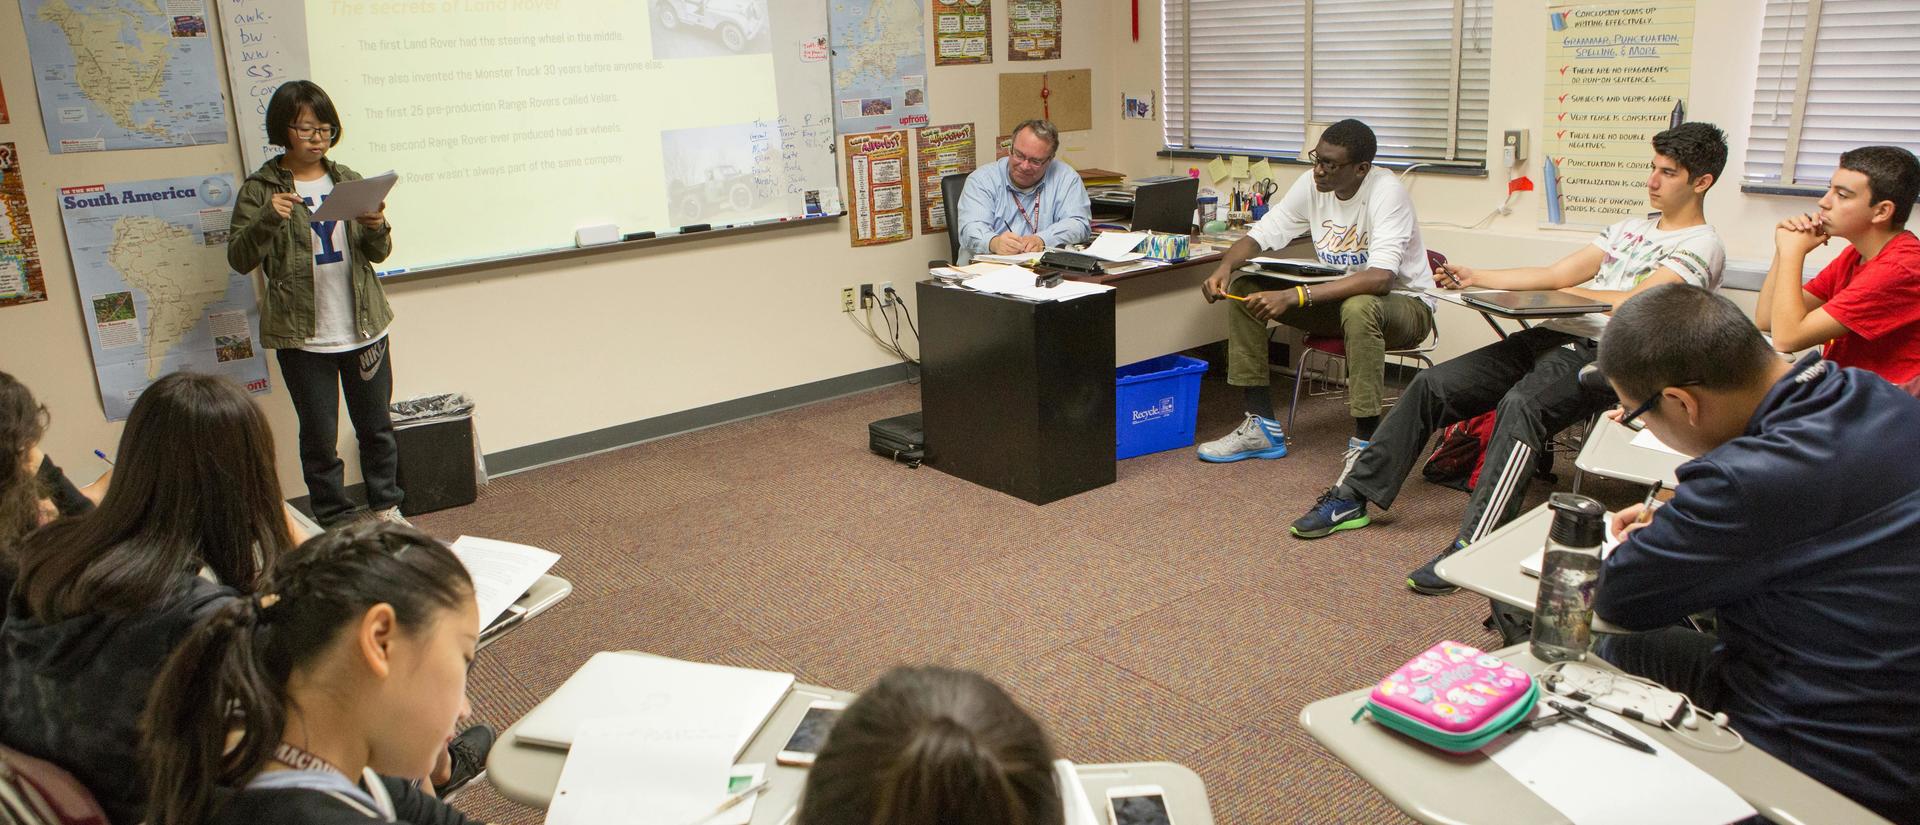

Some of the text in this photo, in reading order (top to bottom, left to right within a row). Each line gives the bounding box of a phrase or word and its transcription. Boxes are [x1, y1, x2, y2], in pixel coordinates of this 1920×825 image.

[329, 0, 560, 15] The secrets of Land Rover
[1575, 7, 1657, 18] CONCLUSION SUMS UP
[1575, 18, 1654, 28] WRITING EFFECTIVELY.
[358, 39, 377, 50] The
[380, 38, 401, 50] first
[403, 37, 427, 50] Land
[430, 36, 456, 49] Rover
[460, 35, 477, 48] had
[480, 35, 495, 47] the
[498, 33, 536, 47] steering
[539, 32, 565, 45] wheel
[567, 32, 574, 42] in
[577, 32, 591, 42] the
[1629, 47, 1656, 56] MORE
[361, 73, 384, 88] They
[388, 71, 409, 84] also
[412, 70, 453, 84] invented
[456, 69, 472, 81] the
[474, 67, 513, 80] Monster
[516, 65, 542, 78] Truck
[544, 64, 556, 76] 30
[557, 64, 582, 78] years
[584, 61, 611, 74] before
[614, 60, 643, 74] anyone
[1597, 66, 1610, 74] ARE
[1624, 66, 1669, 74] FRAGMENTS
[1572, 76, 1582, 84] OR
[1583, 76, 1611, 84] RUN-ON
[1571, 95, 1603, 103] SUBJECTS
[364, 107, 383, 120] The
[386, 105, 407, 119] first
[426, 99, 496, 119] pre-production
[499, 98, 527, 112] Range
[529, 96, 560, 109] Rovers
[562, 93, 588, 107] called
[900, 114, 928, 127] upfront
[1590, 114, 1611, 122] TENSE
[368, 141, 385, 153] The
[391, 138, 427, 152] second
[428, 136, 458, 150] Range
[461, 134, 488, 146] Rover
[490, 133, 510, 144] ever
[512, 128, 554, 144] produced
[556, 126, 573, 138] had
[575, 125, 588, 136] six
[1569, 131, 1591, 139] THERE
[1567, 158, 1616, 169] PUNCTUATION
[406, 170, 435, 183] Rover
[438, 168, 471, 182] wasn't
[473, 165, 506, 180] always
[508, 162, 527, 176] part
[529, 160, 539, 173] of
[540, 159, 555, 171] the
[558, 158, 583, 170] same
[1566, 177, 1620, 186] CAPITALIZATION
[63, 186, 197, 210] South America
[1566, 194, 1597, 203] SPELLING
[1609, 199, 1644, 207] UNKNOWN
